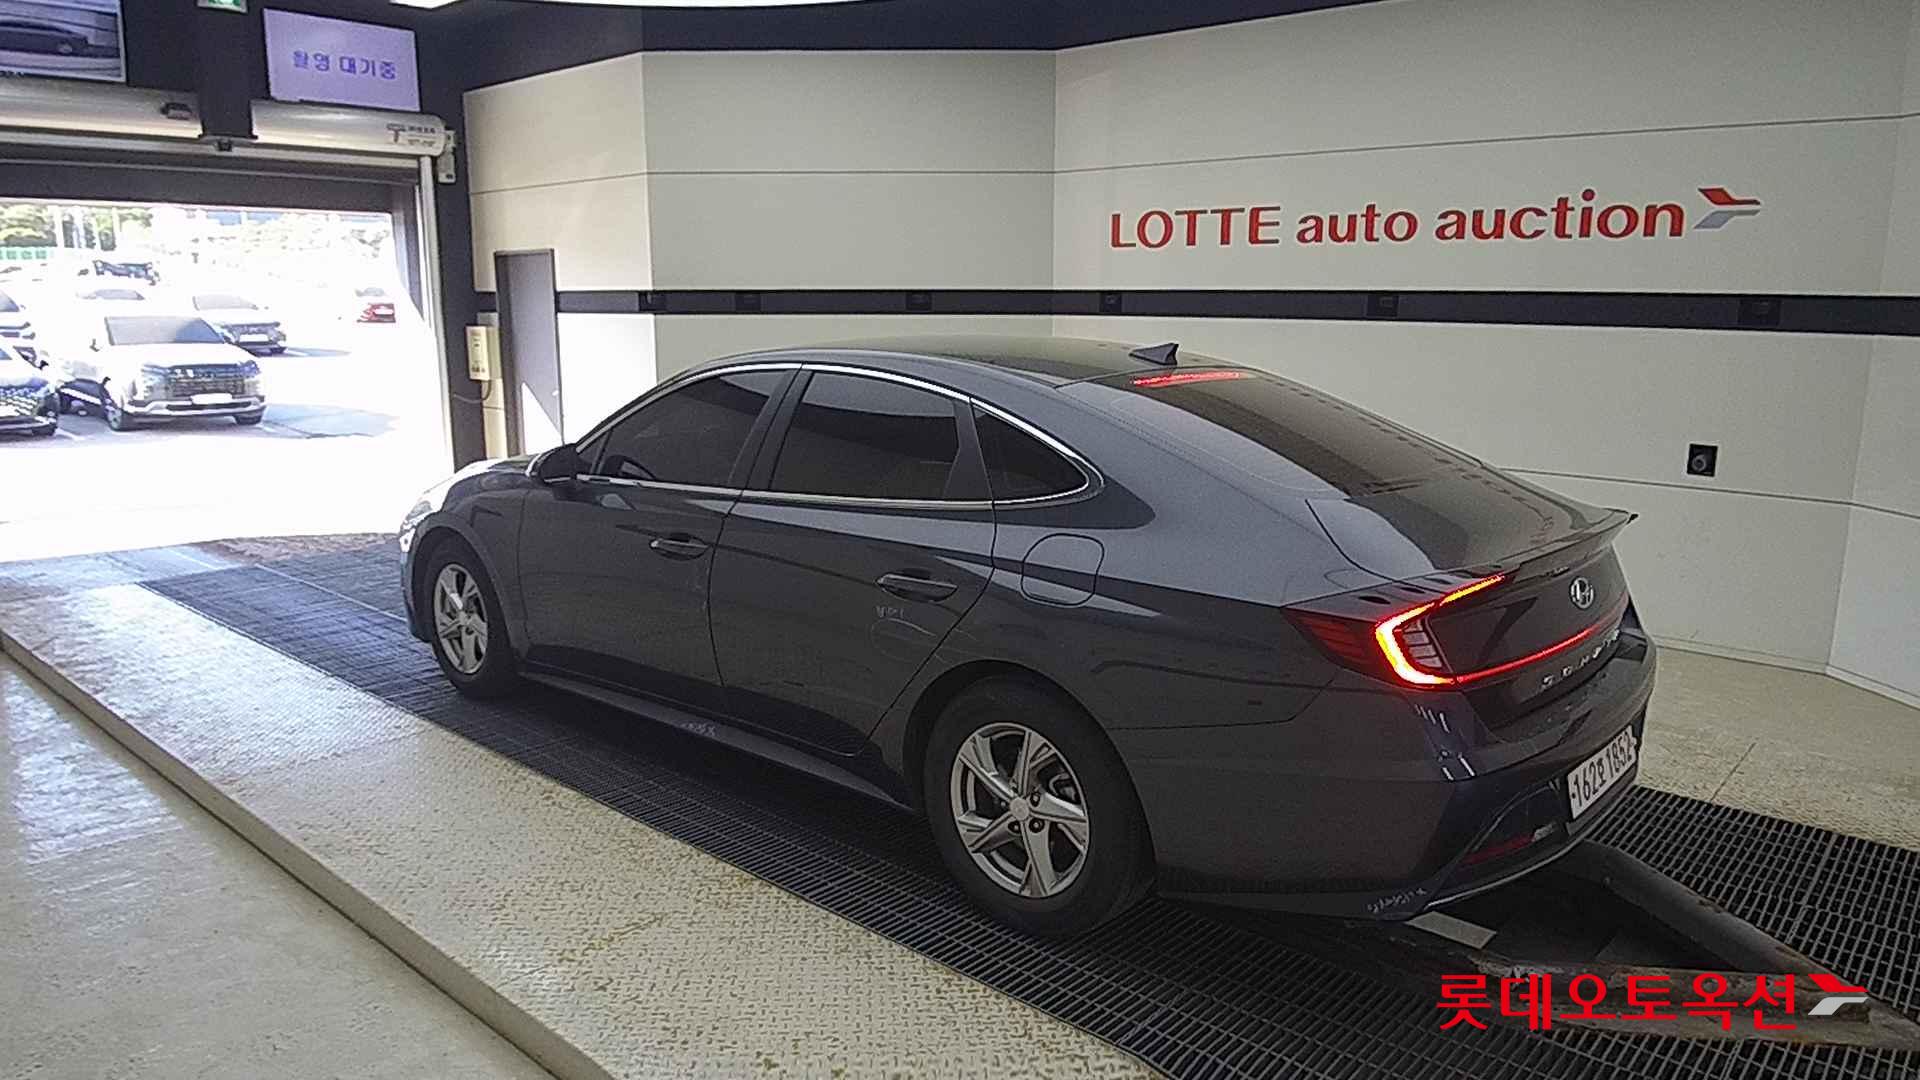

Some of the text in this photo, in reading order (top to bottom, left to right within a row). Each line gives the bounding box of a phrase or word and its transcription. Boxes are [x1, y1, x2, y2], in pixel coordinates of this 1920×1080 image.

[339, 56, 396, 80] 대기중
[1111, 189, 1685, 248] LOTTE auto auction
